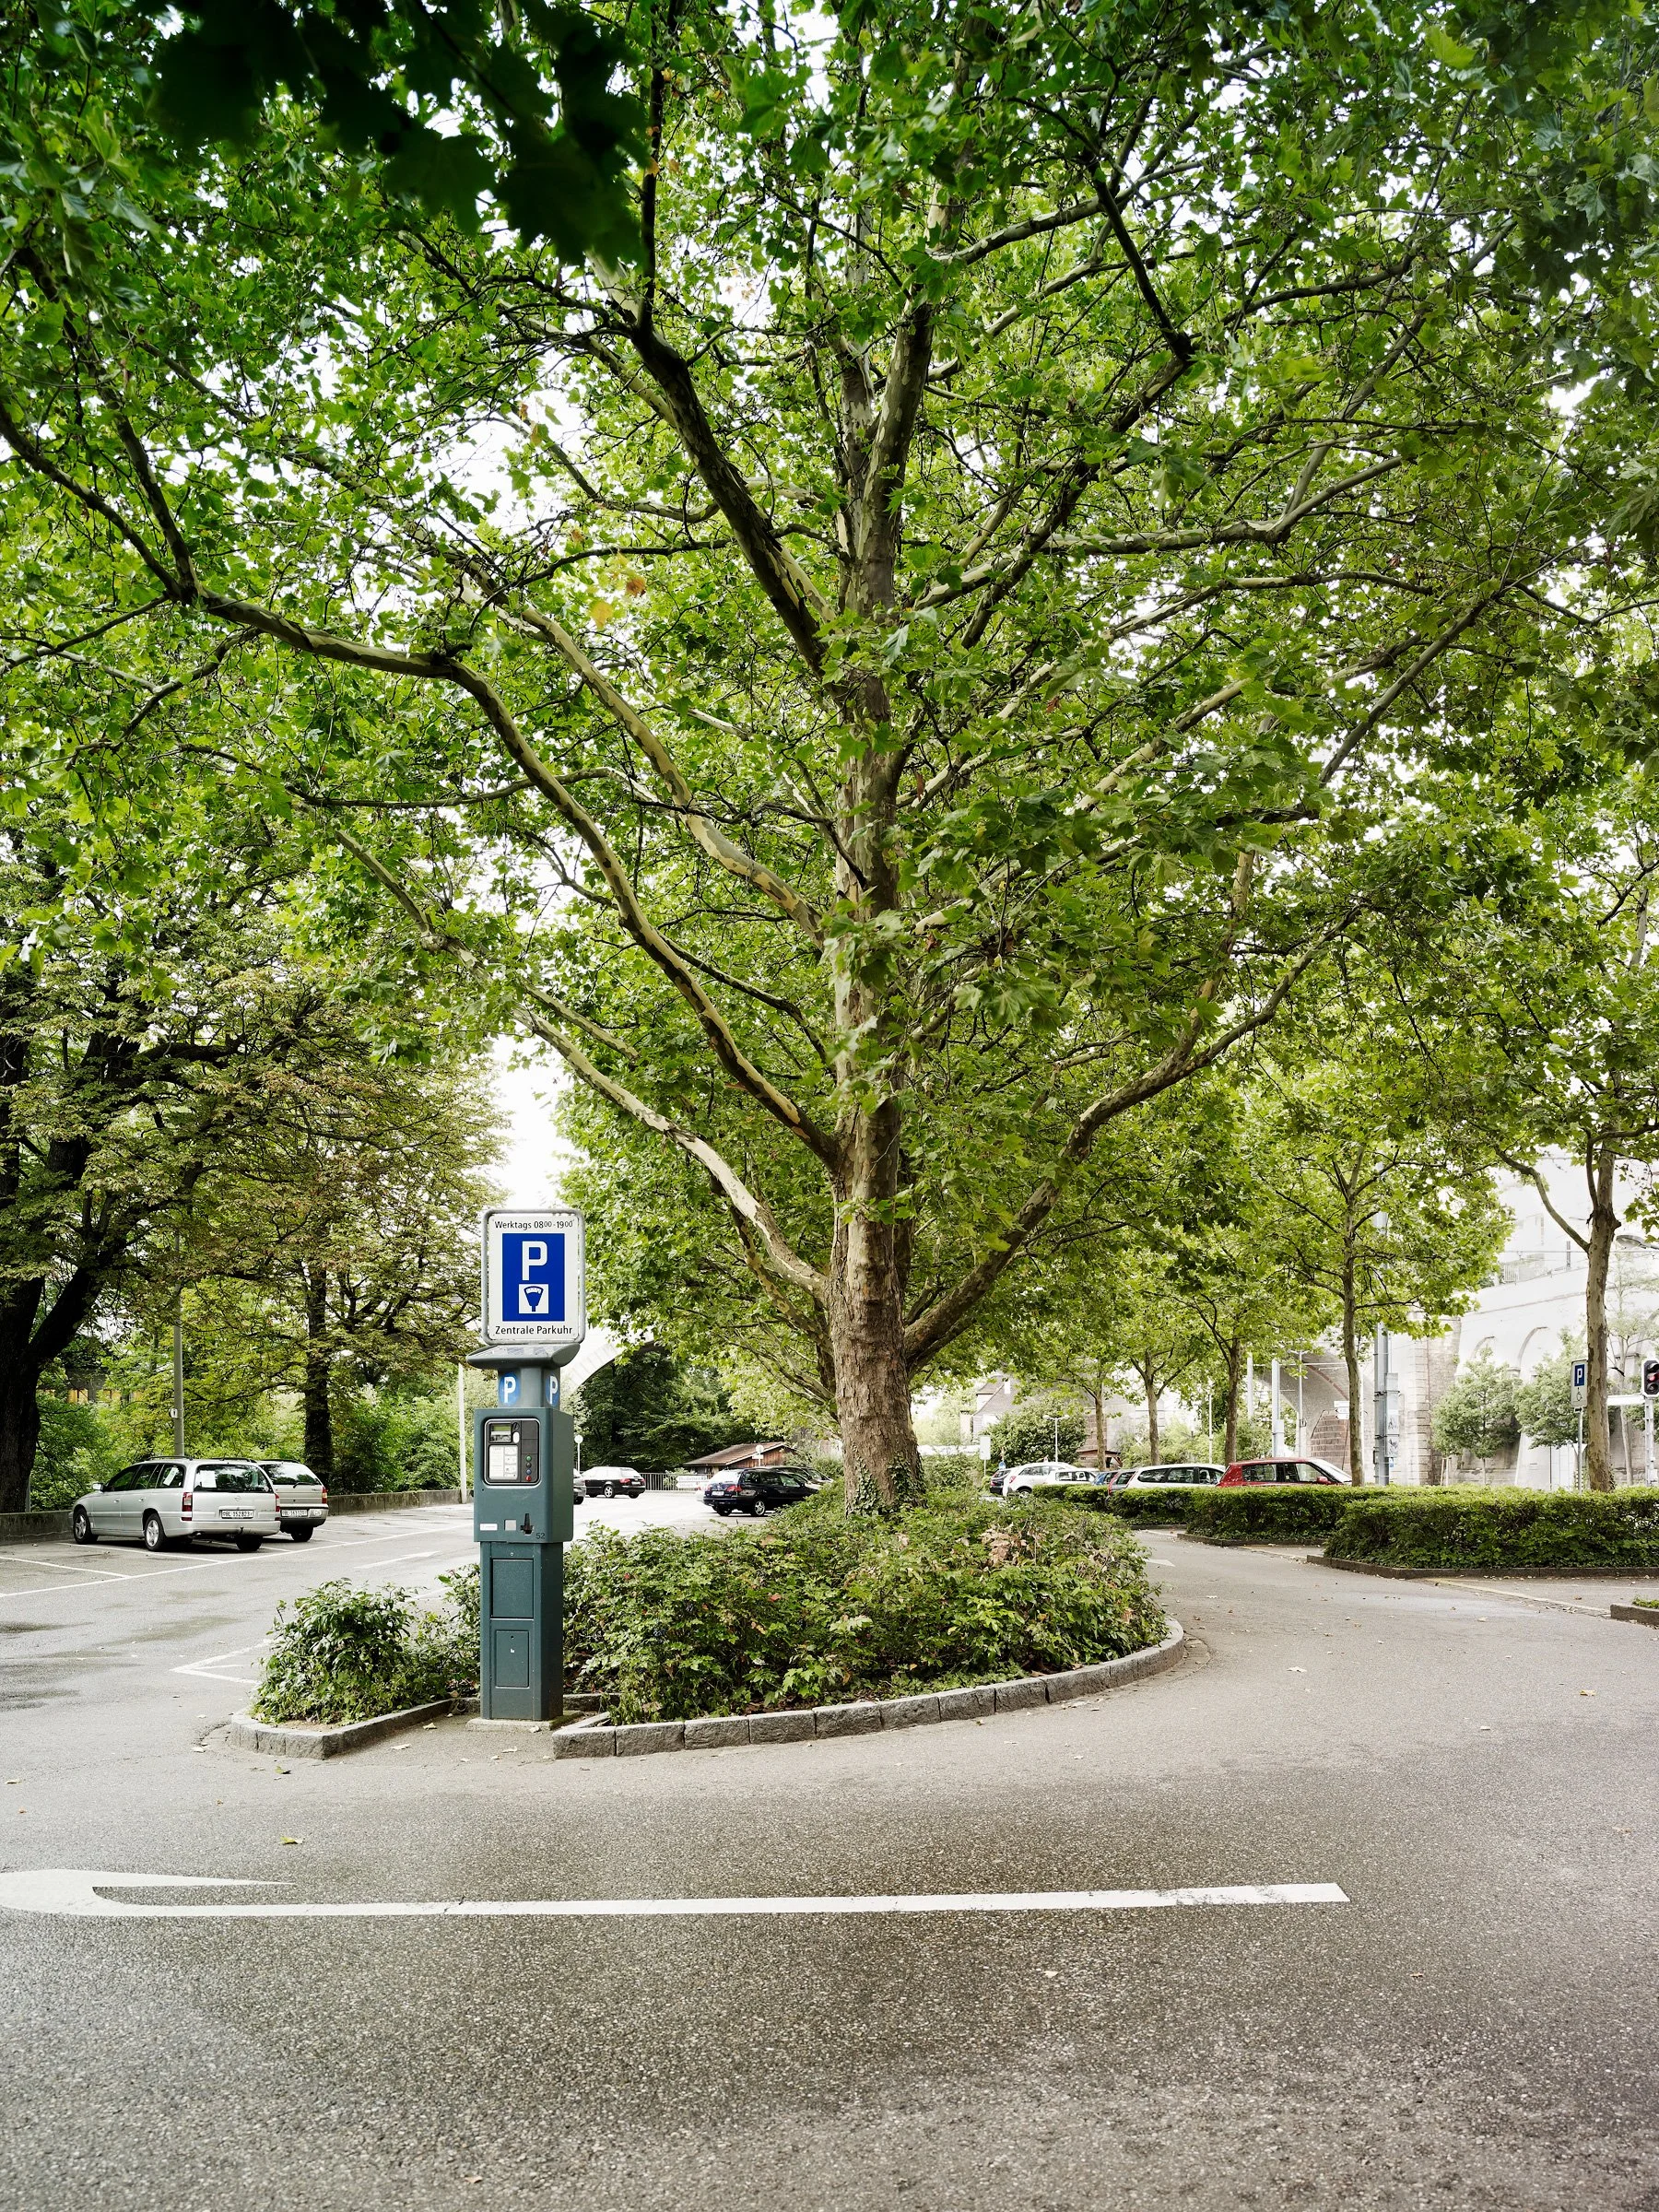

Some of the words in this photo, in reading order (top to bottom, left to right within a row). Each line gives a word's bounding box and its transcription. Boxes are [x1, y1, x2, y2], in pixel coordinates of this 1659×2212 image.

[494, 1220, 532, 1231] Werktags
[522, 1241, 548, 1281] P
[495, 1325, 535, 1335] Zentrale
[536, 1325, 573, 1335] Parkuhr
[1576, 1368, 1583, 1384] P
[504, 1376, 516, 1404] P
[549, 1375, 559, 1405] P
